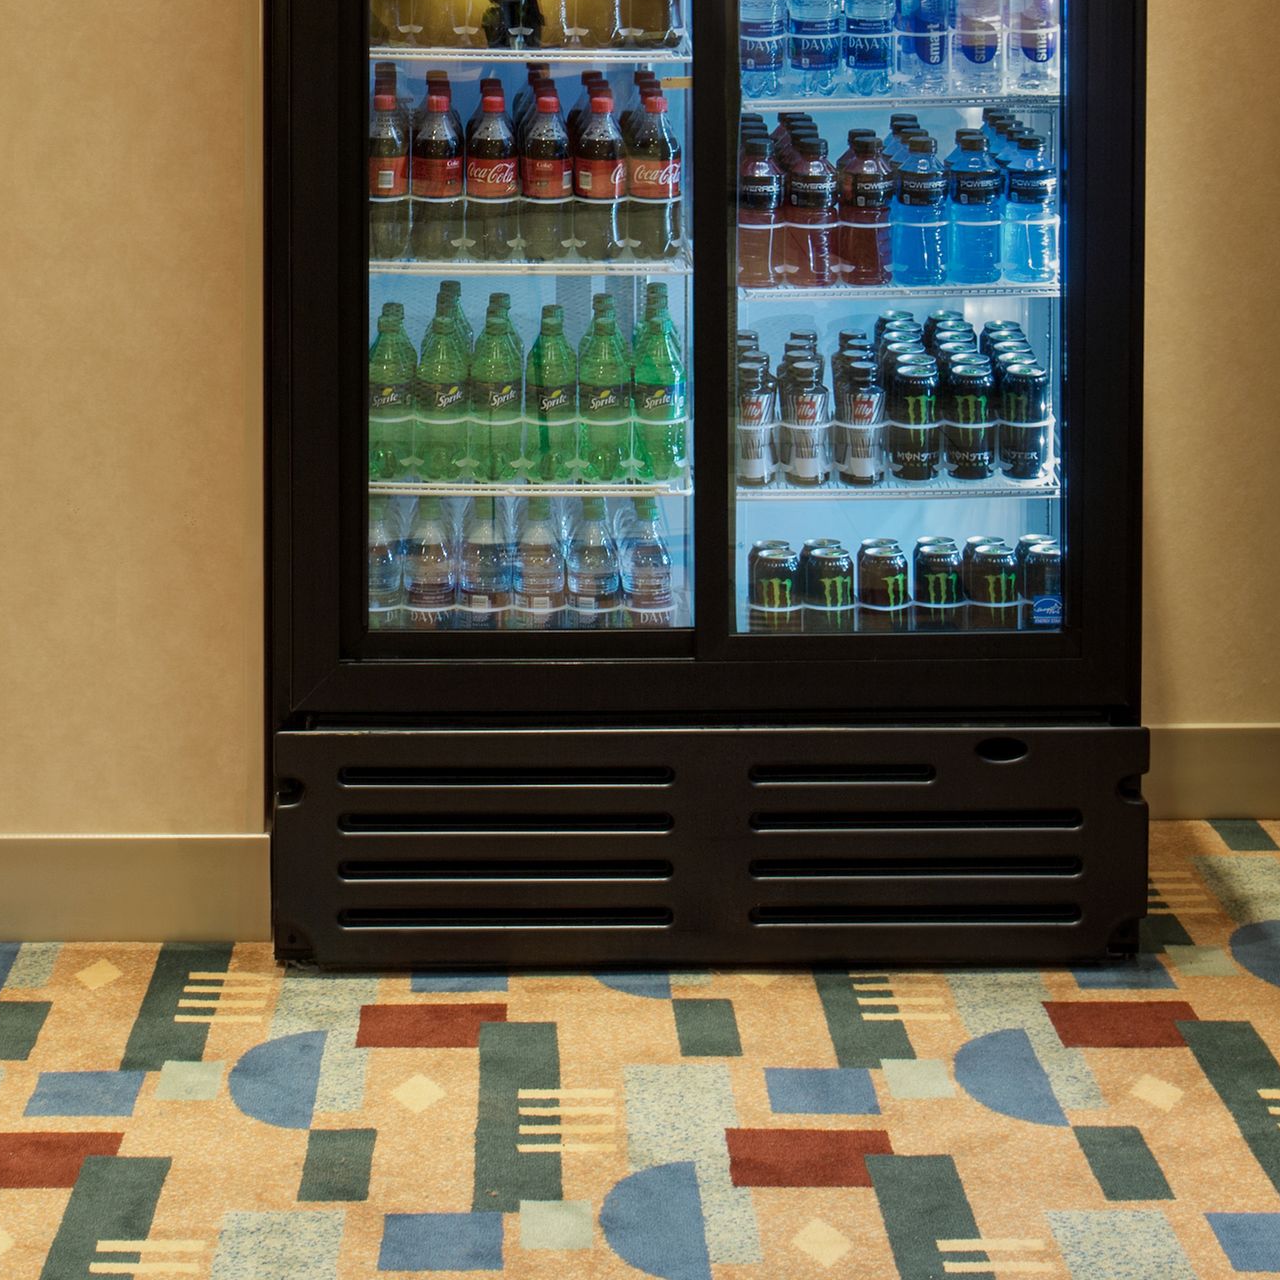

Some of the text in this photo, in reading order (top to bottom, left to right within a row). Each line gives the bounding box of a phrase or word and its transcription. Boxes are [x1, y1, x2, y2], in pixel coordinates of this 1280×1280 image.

[372, 393, 399, 407] Sprite
[437, 391, 463, 408] Sprite
[540, 395, 567, 410] Sprite
[590, 395, 616, 410] Sprite
[798, 404, 815, 417] illy
[855, 403, 872, 417] illy
